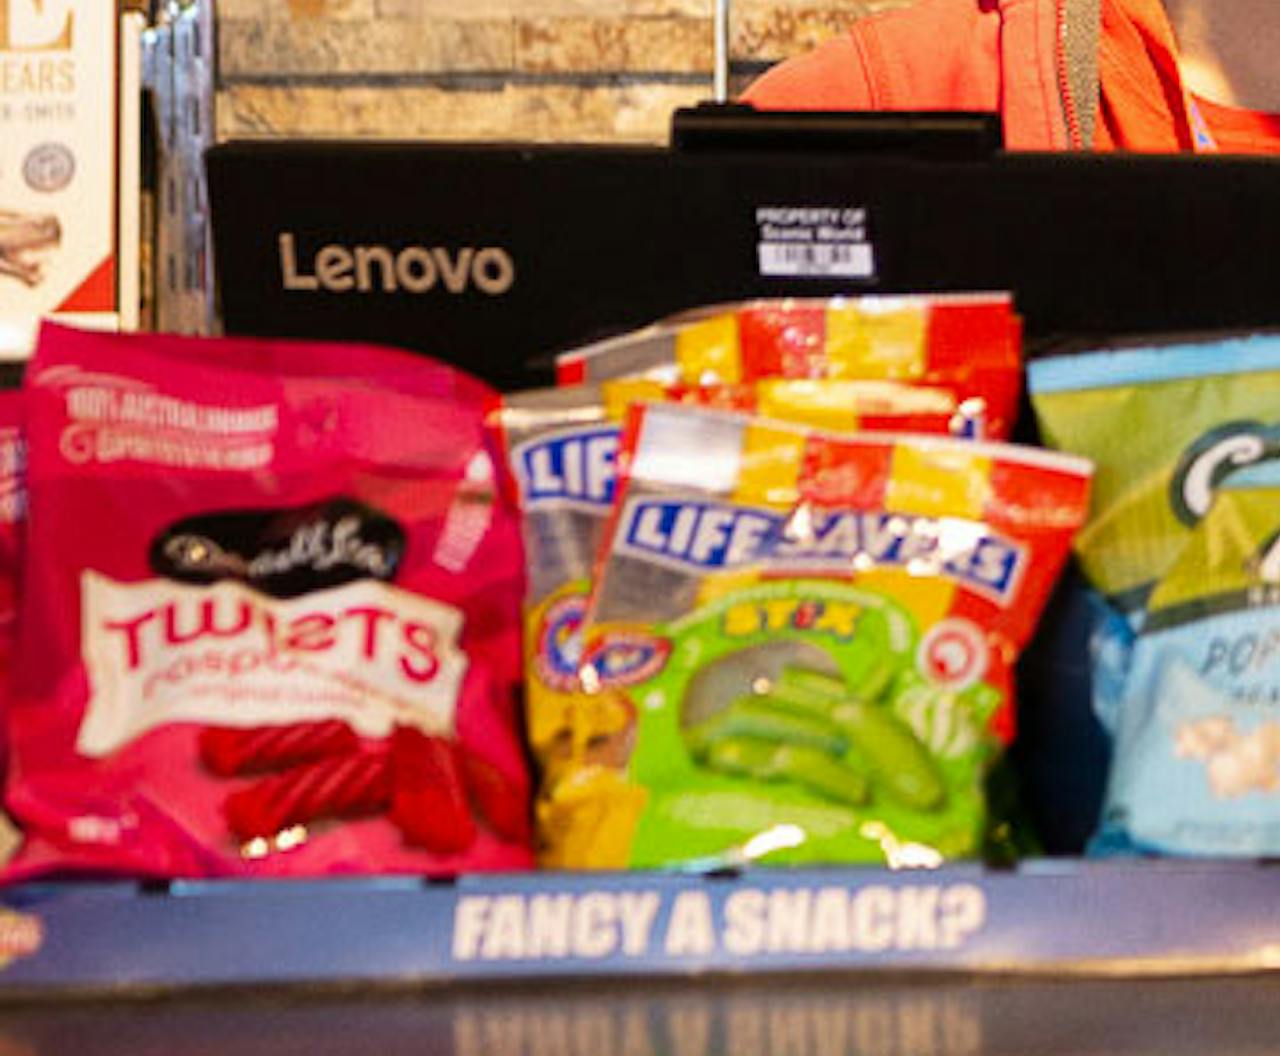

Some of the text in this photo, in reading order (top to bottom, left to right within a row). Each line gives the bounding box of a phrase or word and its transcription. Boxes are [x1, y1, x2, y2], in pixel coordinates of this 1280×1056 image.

[756, 206, 839, 225] PROPERTY
[280, 232, 515, 294] Lenovo
[634, 504, 772, 566] LIFE
[453, 884, 987, 961] FANCY A SNACK?
